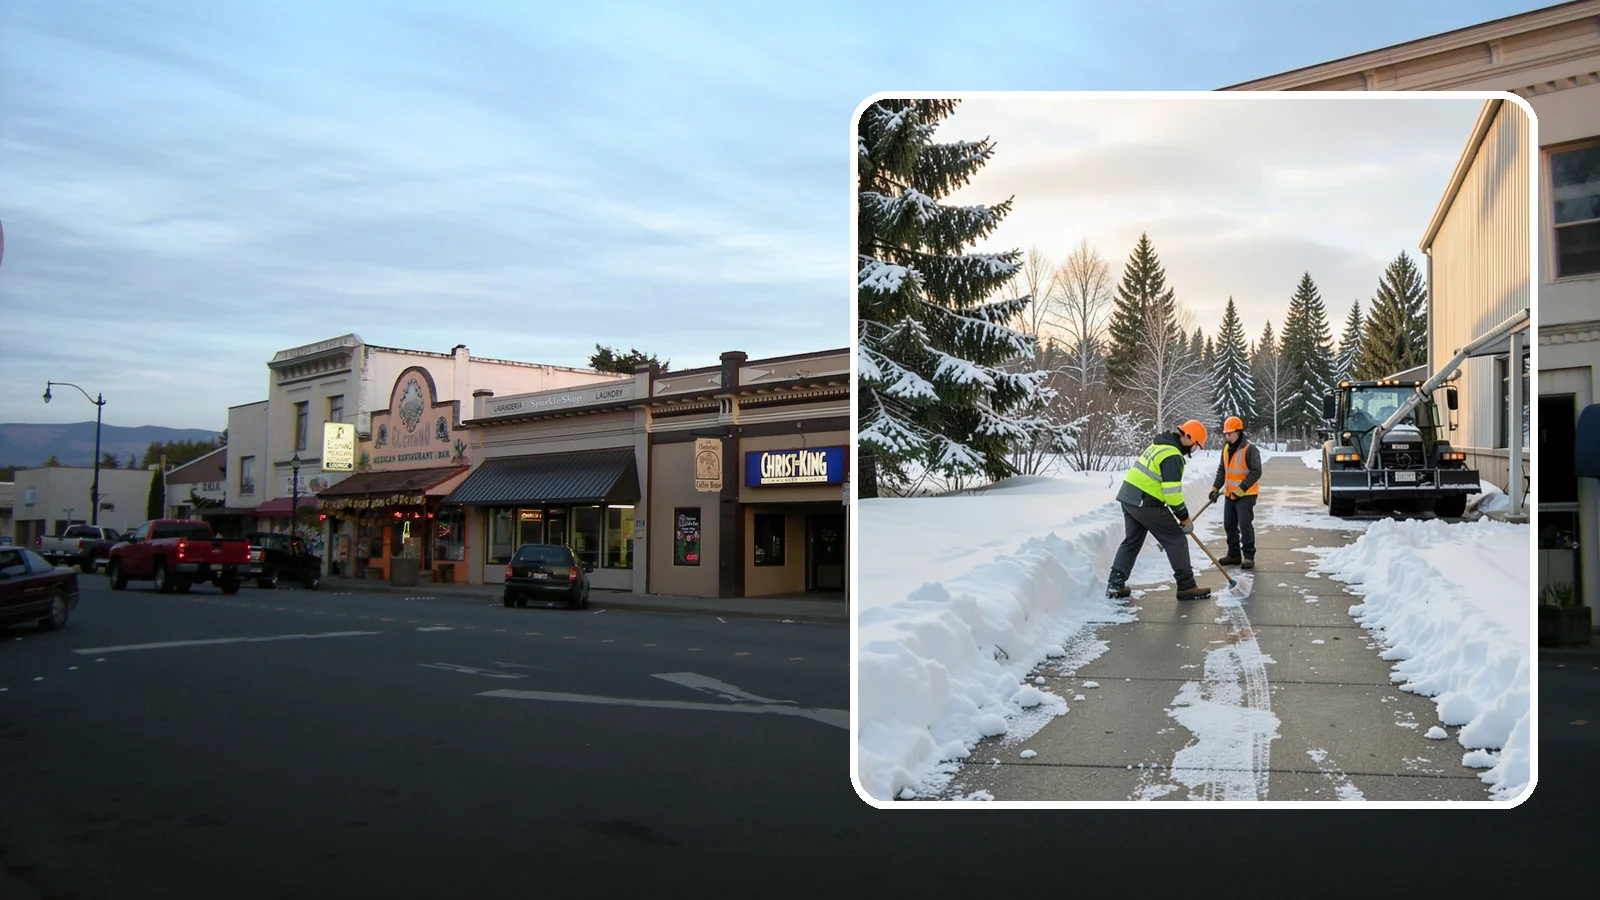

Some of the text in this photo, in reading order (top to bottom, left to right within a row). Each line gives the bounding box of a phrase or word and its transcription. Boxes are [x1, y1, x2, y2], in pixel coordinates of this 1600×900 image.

[562, 394, 582, 404] Shop
[596, 389, 623, 400] LAUNDRY
[493, 402, 522, 412] LAVANDERIA
[397, 451, 433, 462] RESTAURANT
[438, 450, 450, 459] BAR
[761, 450, 827, 477] CHRIST KING
